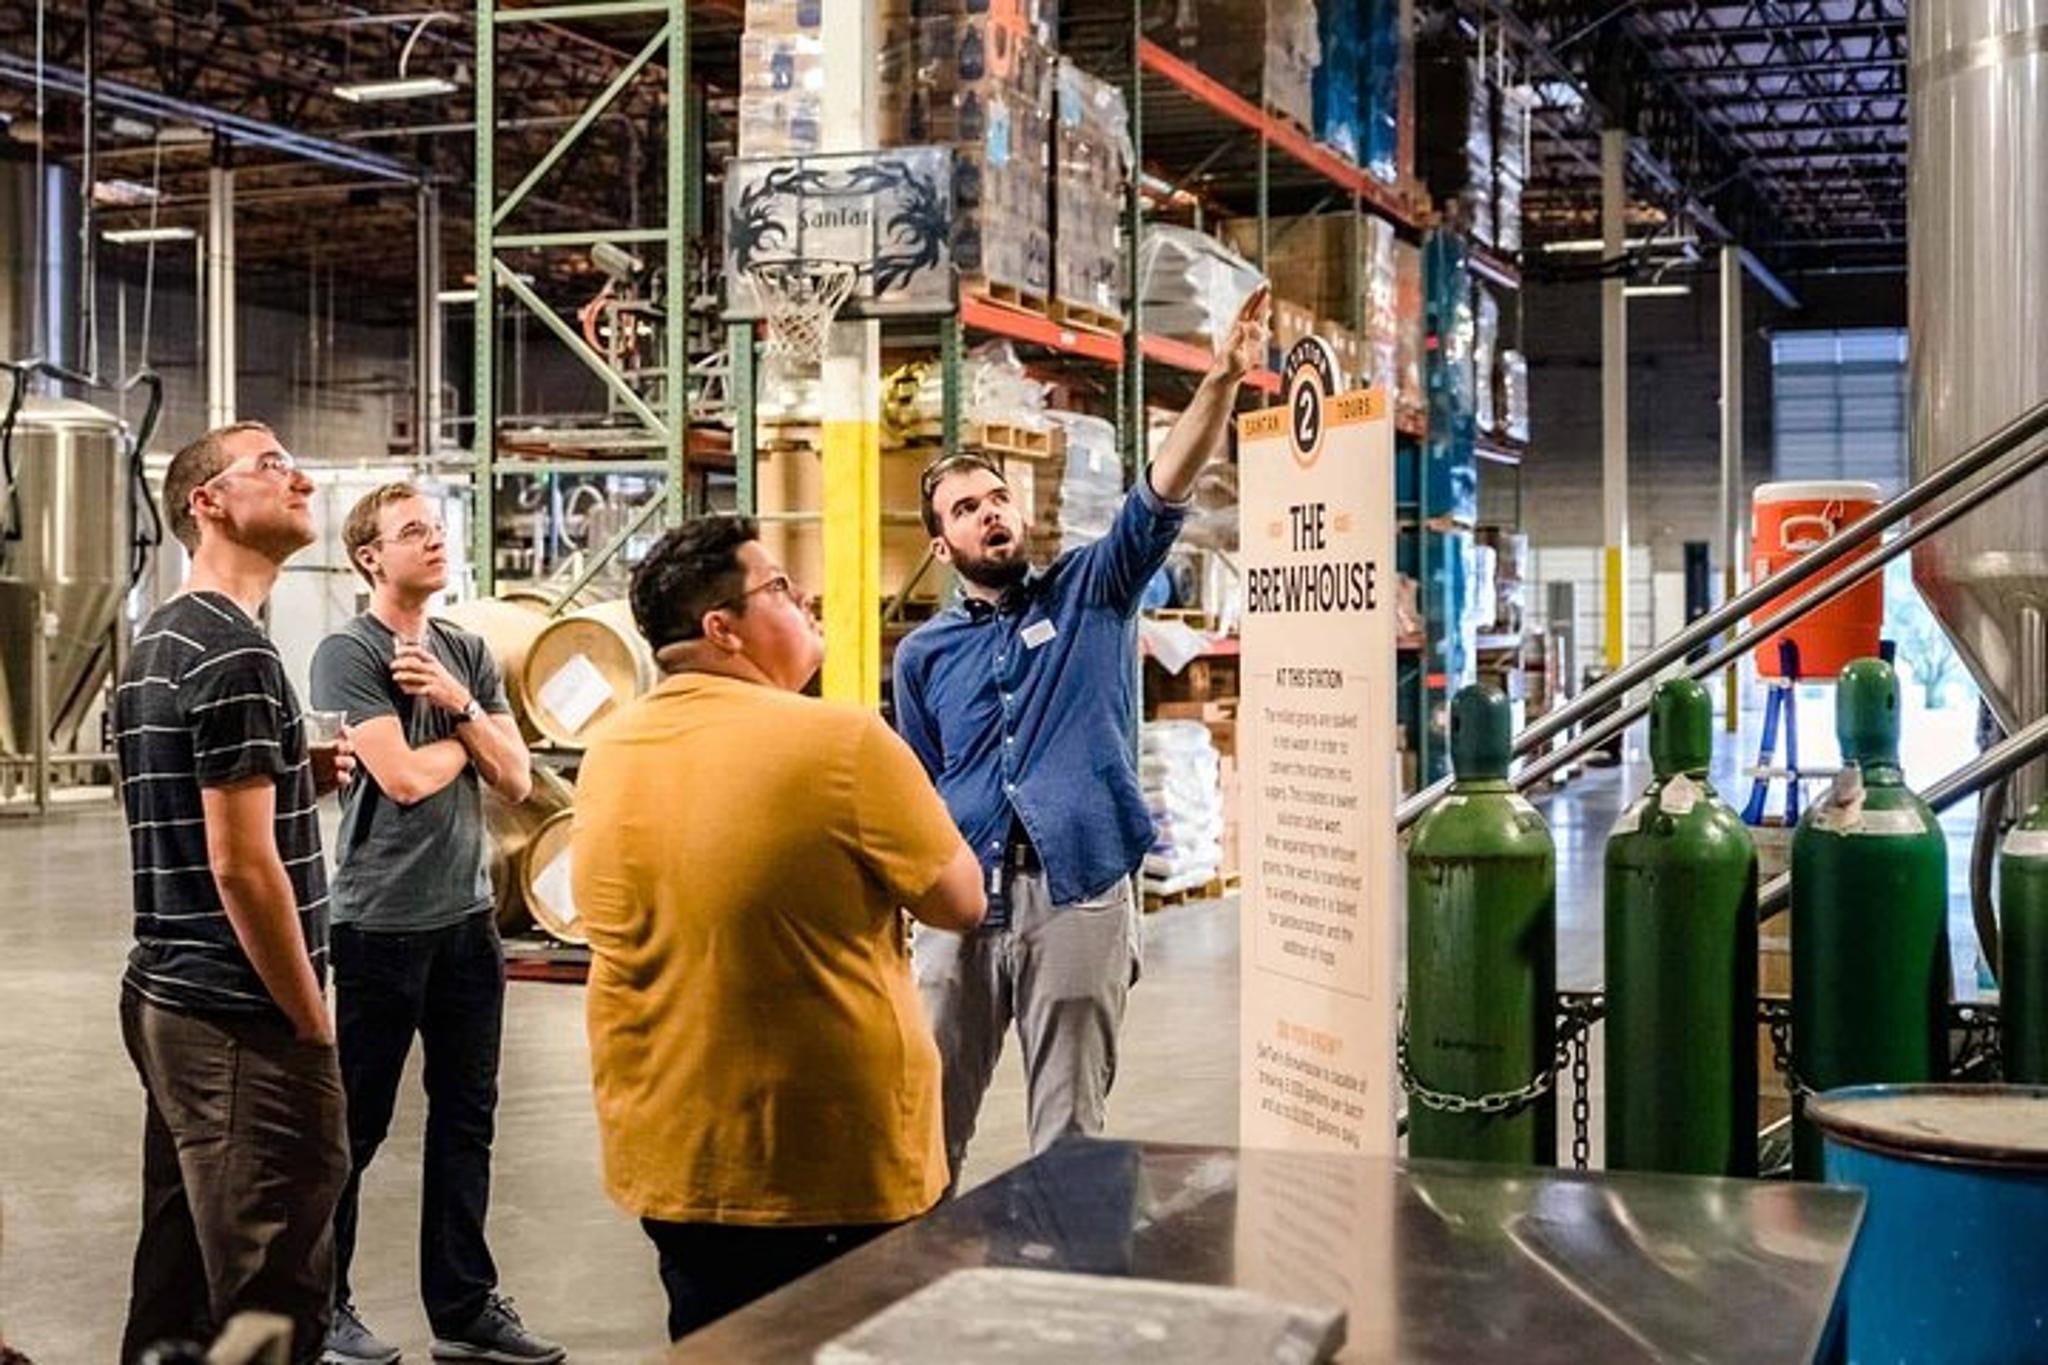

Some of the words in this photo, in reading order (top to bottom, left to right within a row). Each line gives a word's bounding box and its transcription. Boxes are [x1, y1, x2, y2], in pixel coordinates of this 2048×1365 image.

[1300, 390, 1313, 440] 2
[1290, 503, 1326, 551] THE
[1248, 562, 1376, 612] BREWHOUSE
[1277, 668, 1286, 686] AT
[1288, 668, 1306, 687] THIS
[1308, 668, 1343, 689] STATION
